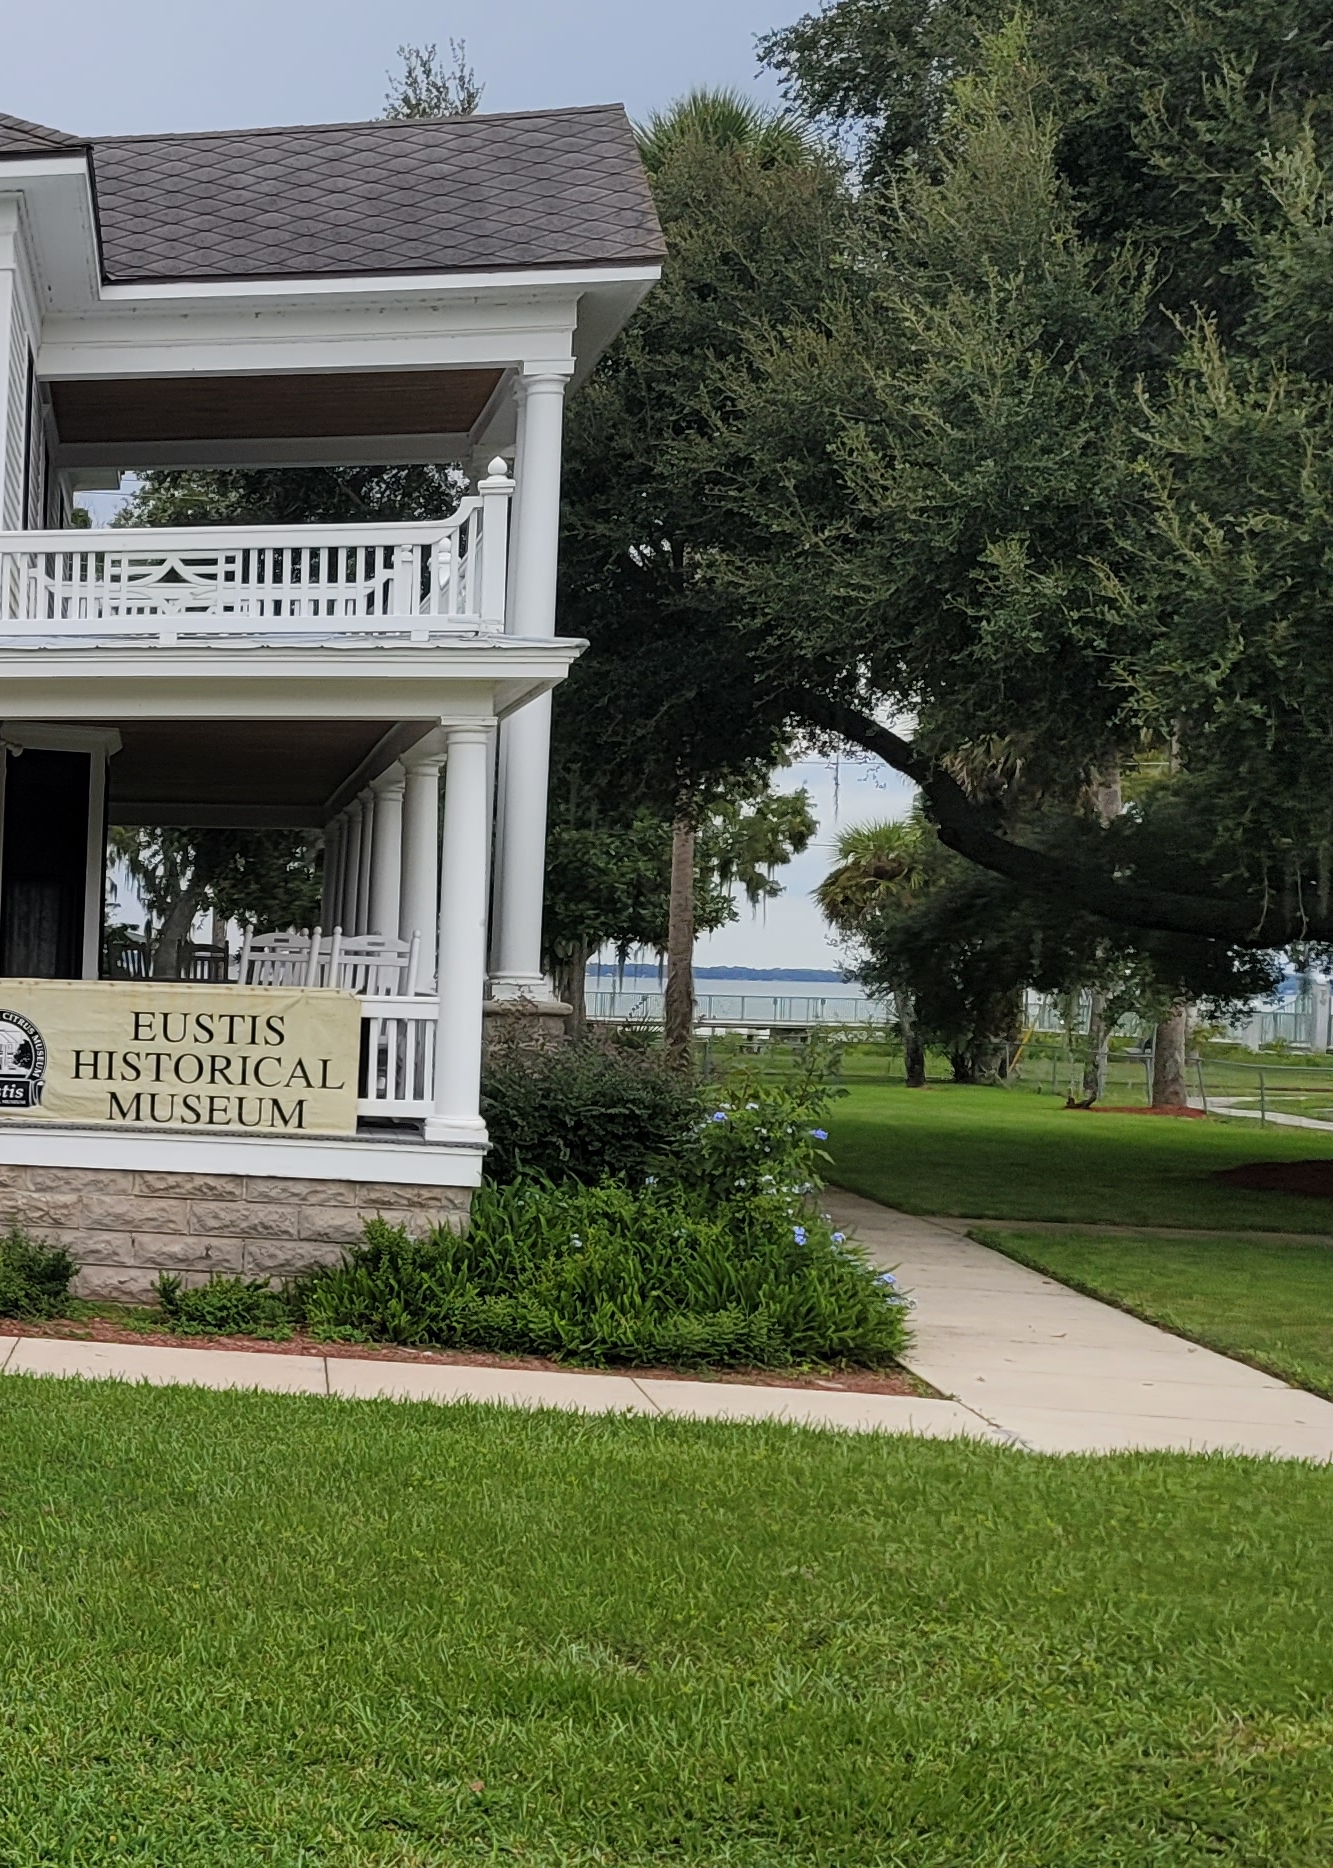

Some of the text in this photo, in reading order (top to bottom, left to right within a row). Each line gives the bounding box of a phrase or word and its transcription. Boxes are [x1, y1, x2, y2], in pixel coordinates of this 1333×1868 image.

[2, 1012, 35, 1035] CITRUS
[31, 1034, 44, 1078] MUSEUM
[129, 1010, 285, 1046] EUSTIS
[70, 1049, 345, 1090] HISTORICAL
[106, 1091, 308, 1129] MUSEUM
